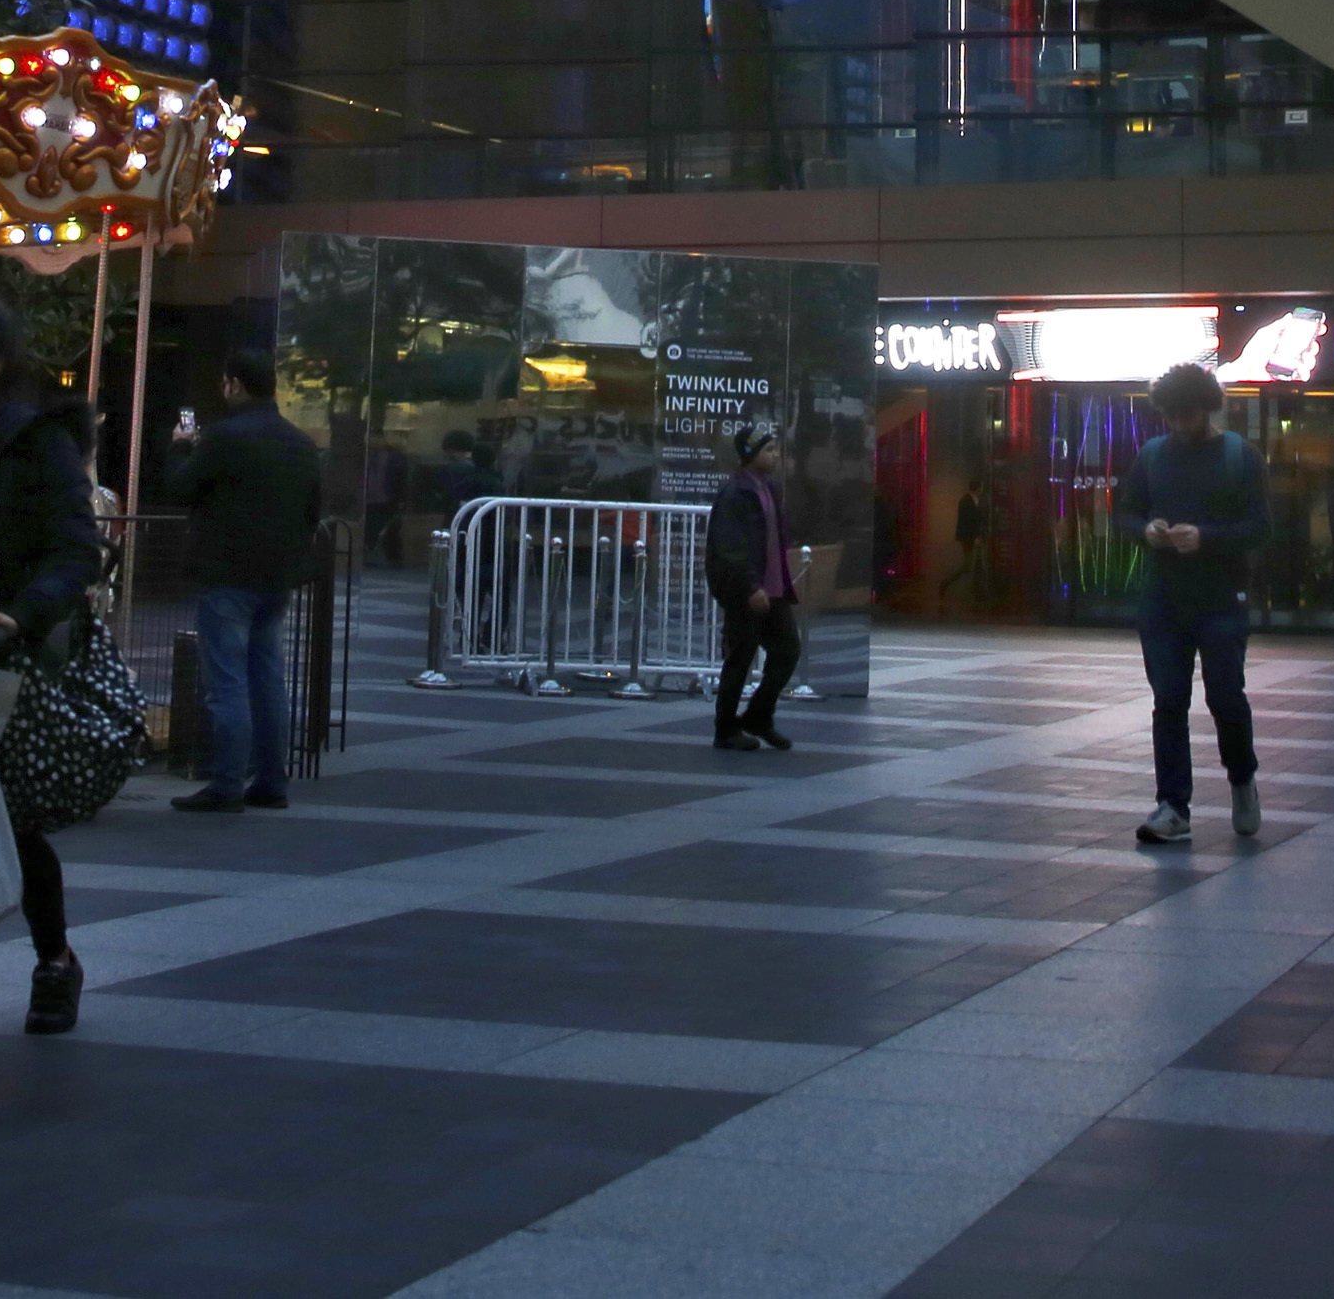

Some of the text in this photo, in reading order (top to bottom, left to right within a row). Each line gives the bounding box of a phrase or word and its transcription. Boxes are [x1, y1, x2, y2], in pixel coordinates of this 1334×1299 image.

[666, 374, 770, 395] TWINKLING
[665, 395, 746, 414] INFINITY
[664, 416, 718, 435] LIGHT
